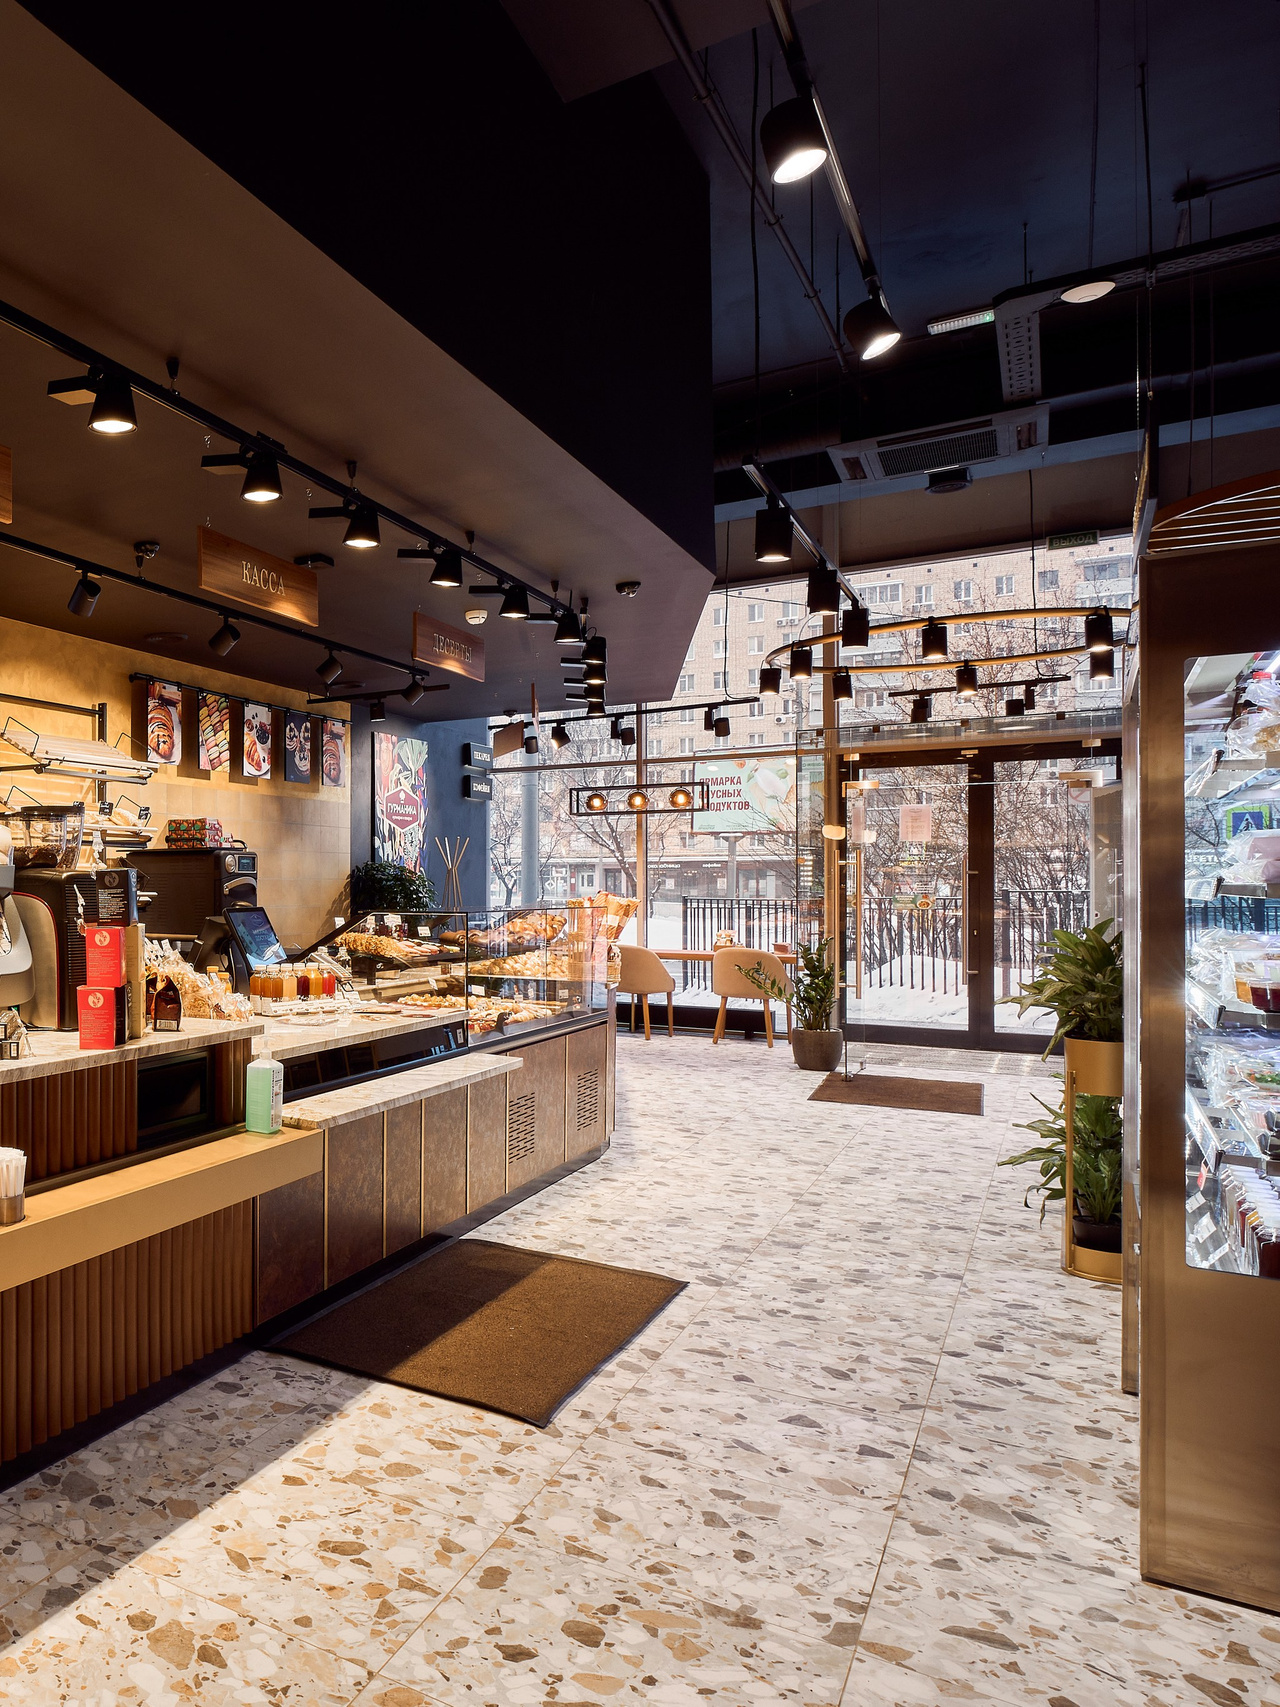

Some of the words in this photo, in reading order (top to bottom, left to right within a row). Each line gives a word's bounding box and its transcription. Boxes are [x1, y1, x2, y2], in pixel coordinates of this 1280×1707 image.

[1053, 535, 1094, 546] ВЫХОД
[241, 561, 286, 596] КАССА
[433, 633, 472, 663] ДЕСЕРТЫ
